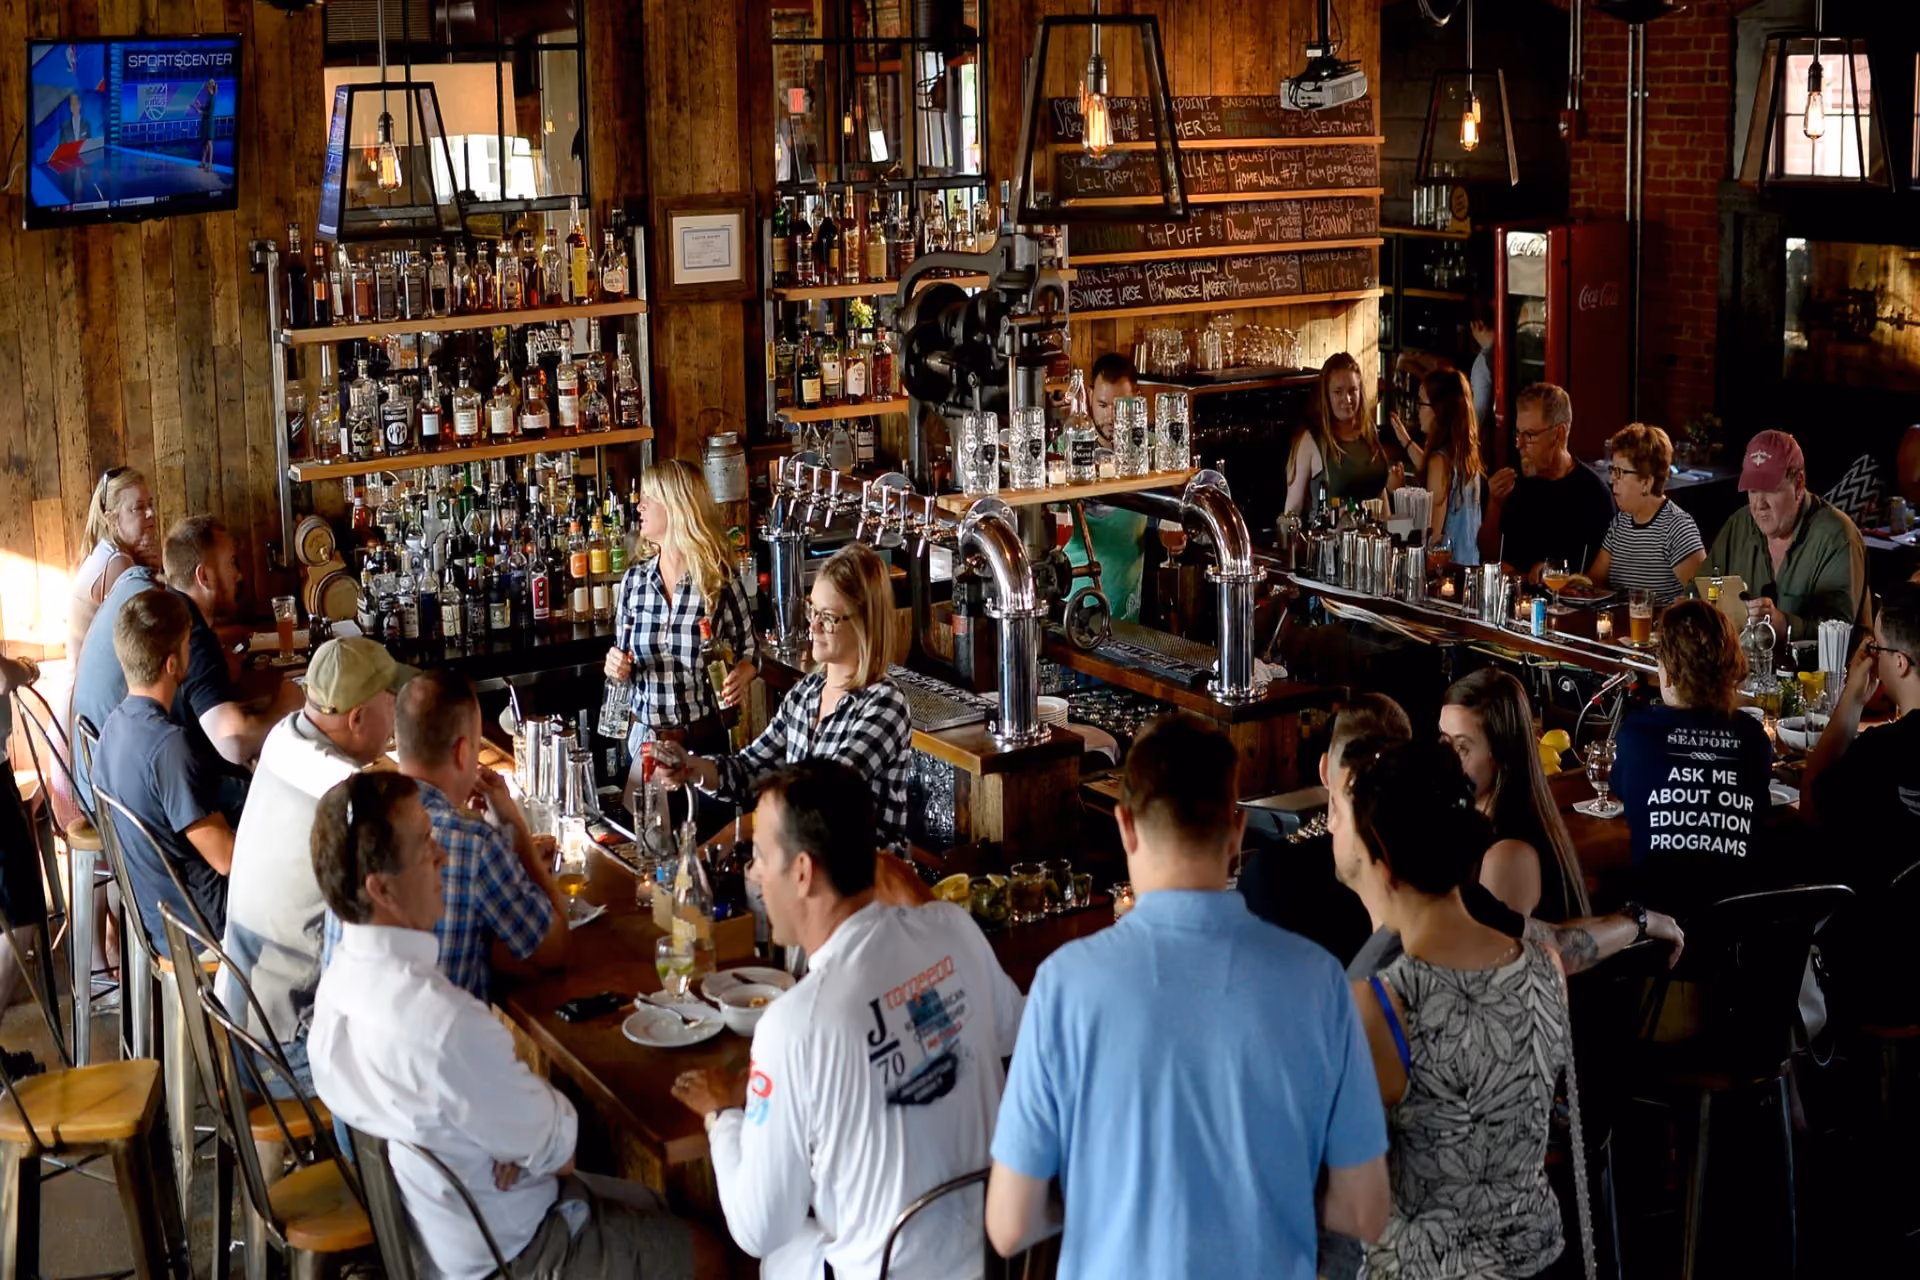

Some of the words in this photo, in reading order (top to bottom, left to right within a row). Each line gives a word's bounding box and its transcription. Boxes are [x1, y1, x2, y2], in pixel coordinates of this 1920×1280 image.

[128, 53, 233, 69] SPORTSCENTER
[1311, 109, 1362, 134] SEXTANT
[1228, 150, 1269, 171] BALLAST
[1269, 149, 1301, 174] POINT
[1306, 168, 1326, 185] CALM
[1303, 199, 1344, 223] BALLAST
[1164, 223, 1204, 247] PUFF
[1145, 260, 1186, 282] FIREFLY
[1188, 258, 1219, 283] HOLLOW
[1267, 266, 1298, 291] PILS
[1667, 734, 1741, 749] SEAPORT
[1668, 766, 1704, 783] ASK
[1712, 769, 1738, 786] ME
[1647, 788, 1711, 806] ABOUT
[1718, 791, 1754, 812] OUR
[1650, 810, 1751, 835] EDUCATION
[1650, 834, 1747, 857] PROGRAMS
